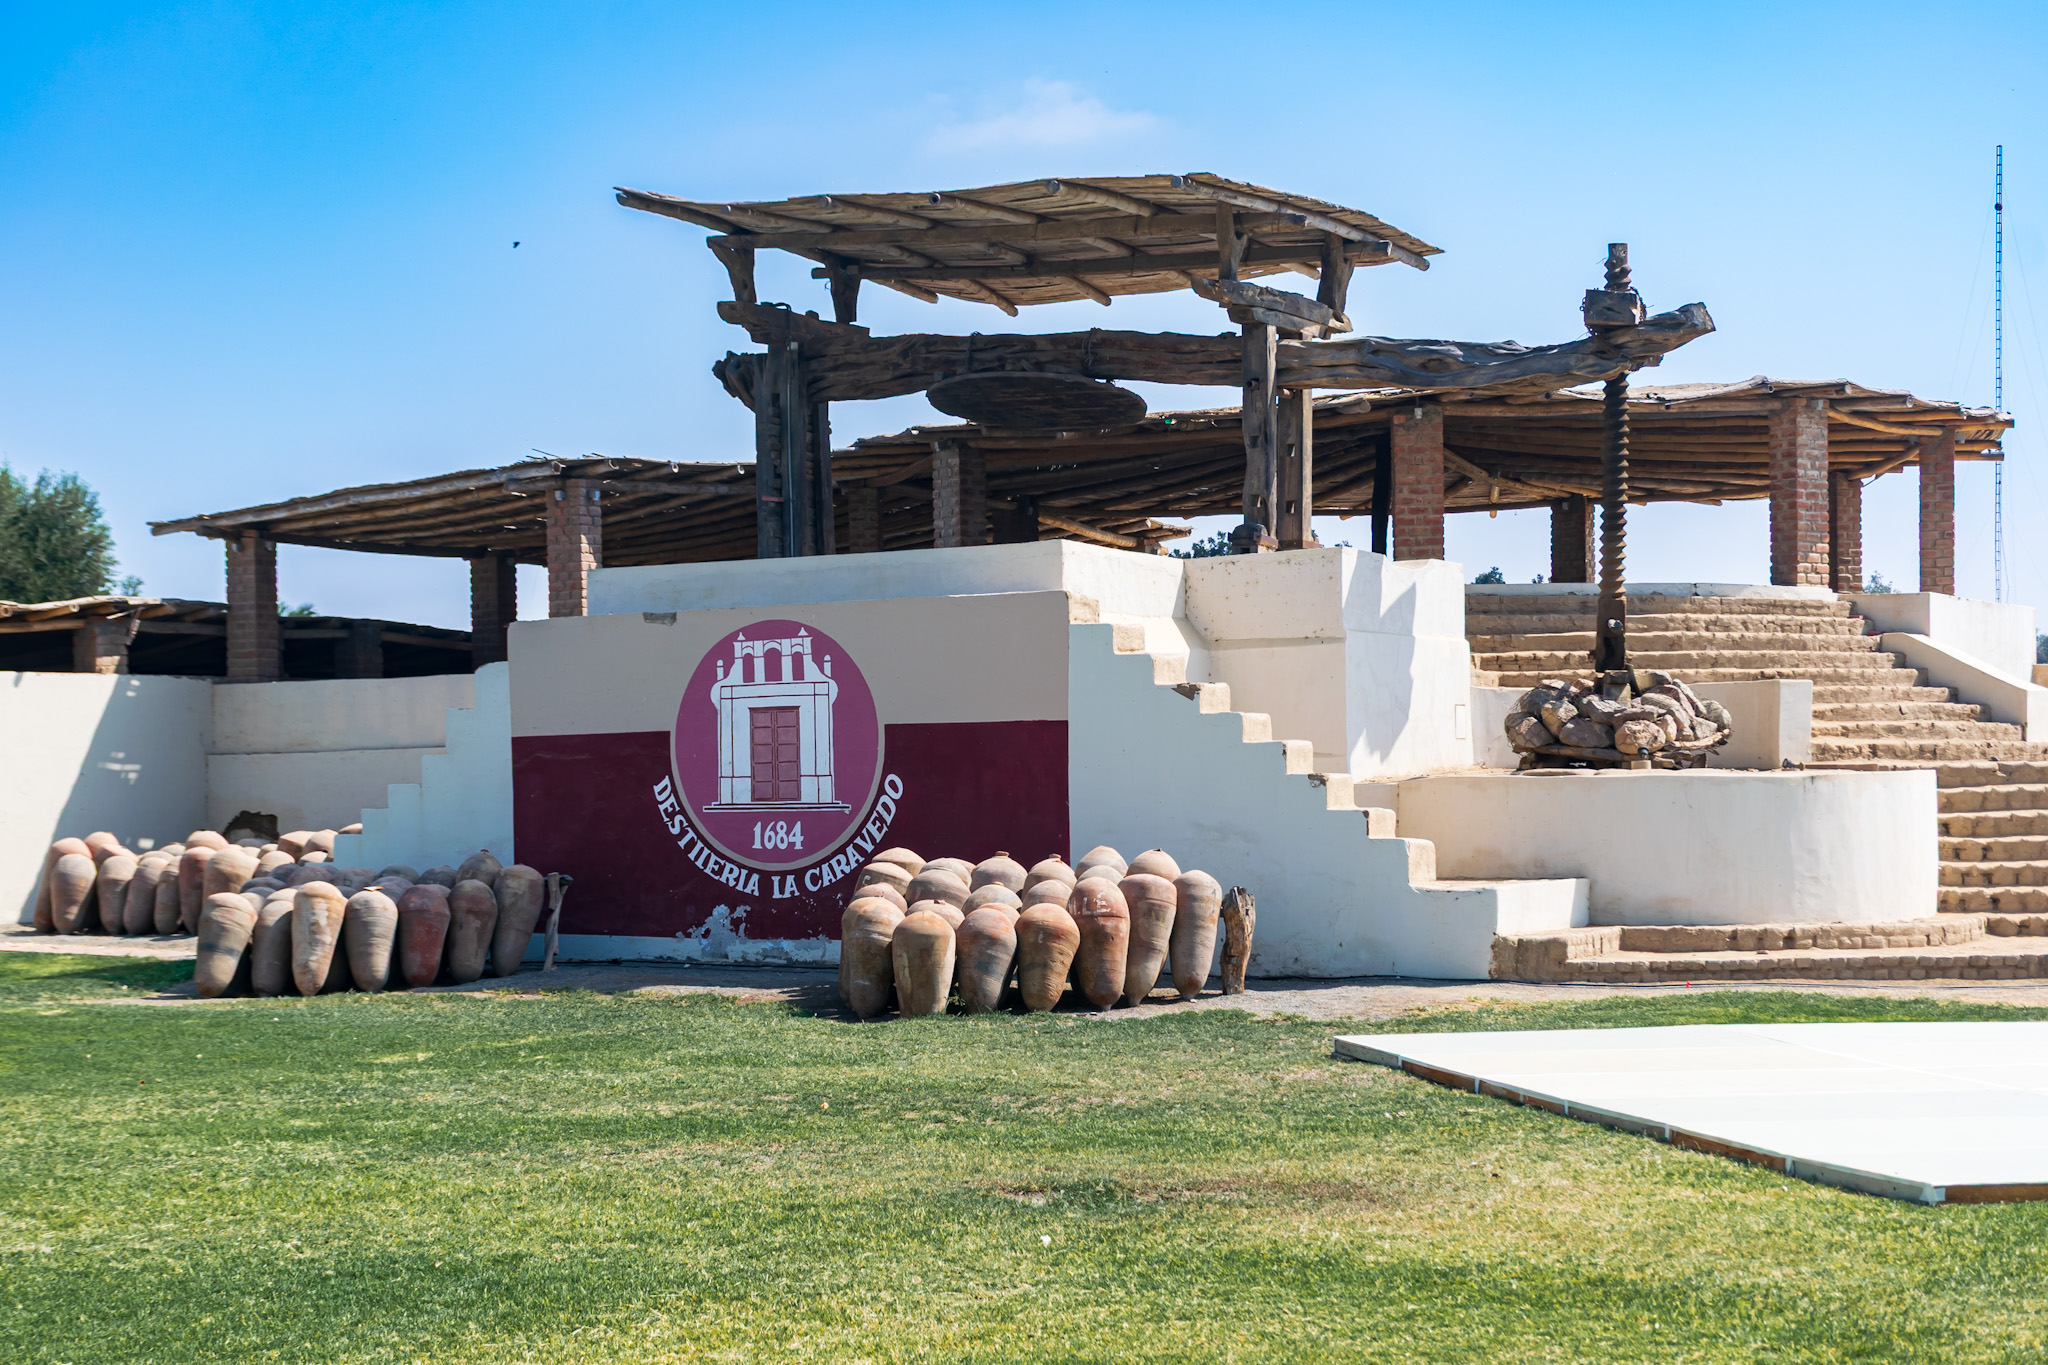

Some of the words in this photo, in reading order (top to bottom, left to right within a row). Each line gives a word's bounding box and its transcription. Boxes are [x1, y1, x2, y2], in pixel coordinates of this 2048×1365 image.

[652, 775, 760, 897] DESTILERIA
[770, 874, 800, 899] LA
[803, 773, 904, 892] CARAVEDO
[751, 820, 805, 850] 1684
